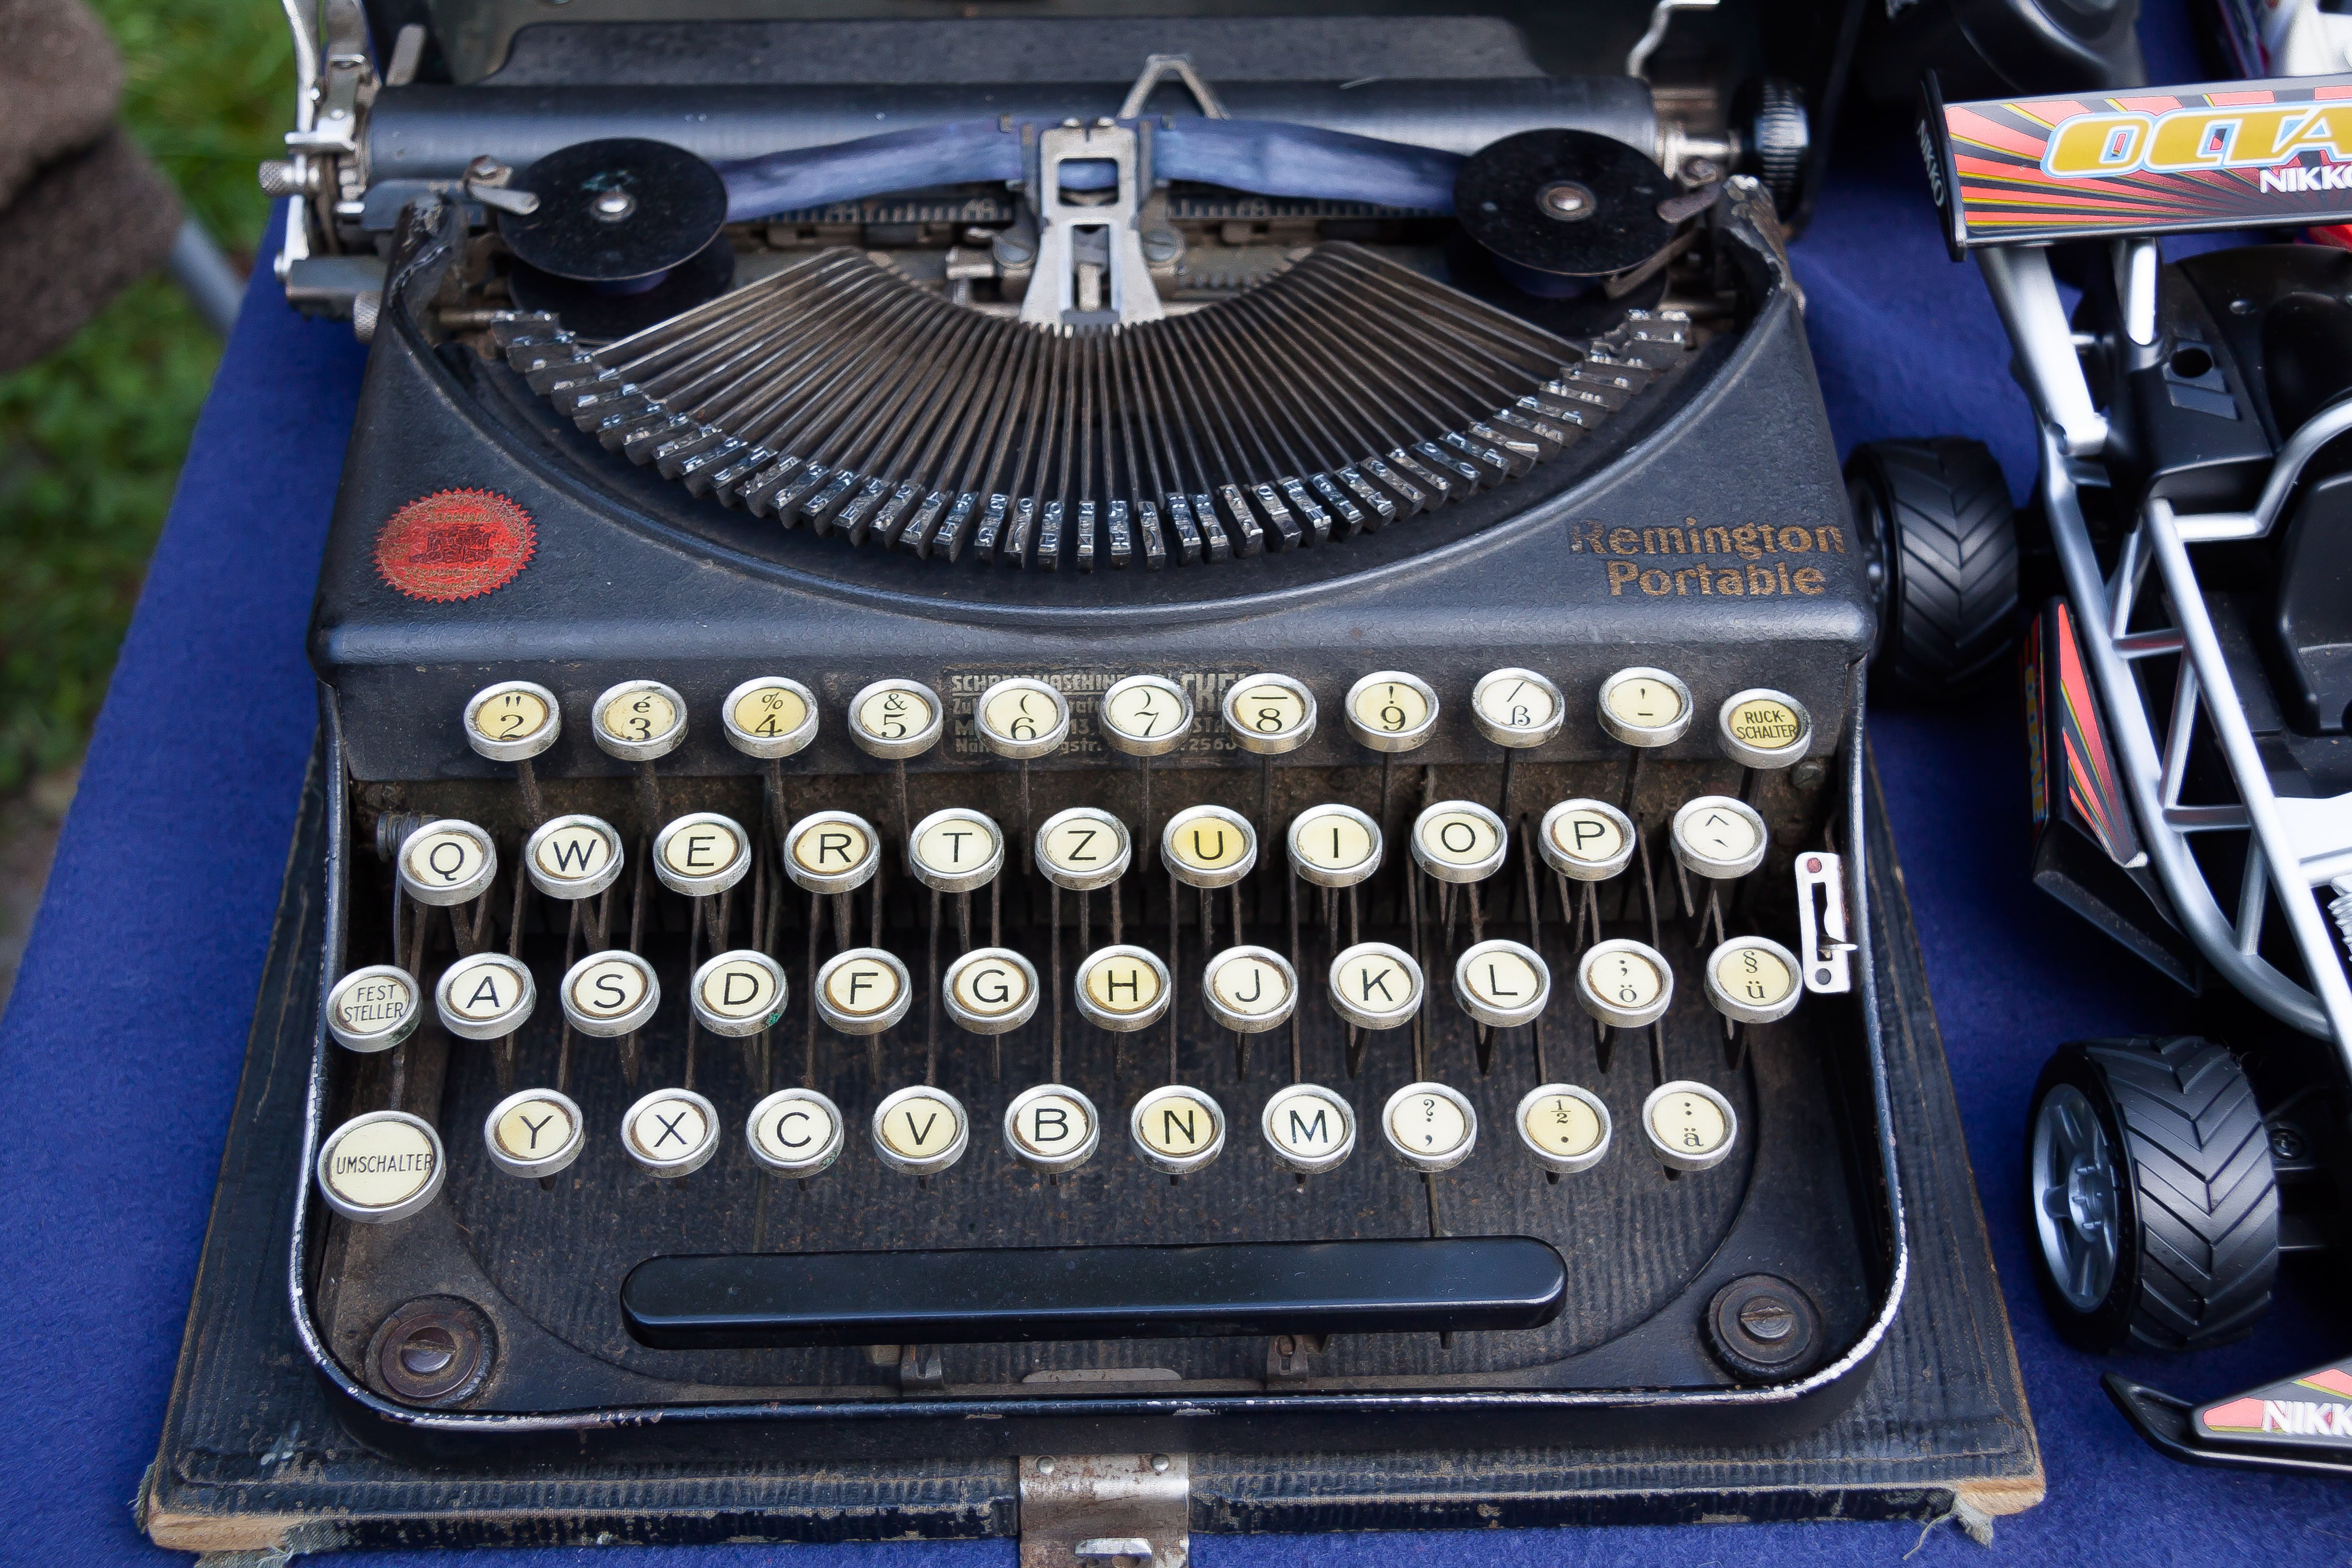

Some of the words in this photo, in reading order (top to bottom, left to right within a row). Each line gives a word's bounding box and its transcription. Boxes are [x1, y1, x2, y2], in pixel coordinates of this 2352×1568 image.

[1569, 517, 1845, 560] Remington
[1606, 559, 1827, 596] Portable
[633, 695, 651, 713] é
[761, 692, 784, 712] %
[883, 692, 908, 711] &
[1388, 685, 1395, 704] !
[499, 714, 525, 739] 2
[626, 717, 652, 741] 3
[754, 714, 783, 736] 4
[881, 713, 907, 738] 5
[1010, 717, 1037, 740] 6
[1133, 711, 1159, 736] 7
[1256, 707, 1283, 733] 8
[1379, 706, 1406, 732] 9
[1735, 724, 1798, 740] SCHALTER
[686, 835, 716, 867] E
[818, 833, 852, 864] R
[942, 832, 973, 863] T
[1067, 830, 1097, 861] Z
[1193, 830, 1224, 861] U
[1333, 827, 1339, 858] I
[1440, 822, 1476, 853] O
[1572, 821, 1605, 850] P
[429, 841, 465, 882] Q
[552, 838, 598, 872] W
[1743, 951, 1759, 974] §
[356, 983, 395, 1002] FEST
[466, 976, 501, 1008] A
[593, 974, 626, 1008] S
[723, 972, 759, 1006] D
[849, 971, 879, 1005] F
[972, 969, 1008, 1004] G
[1108, 969, 1138, 1002] H
[1234, 968, 1260, 1002] J
[1362, 968, 1393, 1002] K
[1489, 964, 1518, 996] L
[1618, 983, 1637, 1003] ö
[1744, 980, 1766, 999] ü
[343, 1002, 404, 1023] STELLER
[1034, 1108, 1069, 1142] B
[1422, 1098, 1435, 1123] ?
[519, 1115, 554, 1149] Y
[654, 1111, 687, 1148] X
[777, 1112, 812, 1148] C
[905, 1111, 937, 1146] V
[1163, 1109, 1195, 1145] N
[1289, 1109, 1328, 1144] M
[1683, 1127, 1705, 1147] ä
[336, 1154, 434, 1176] UMSCHALTER
